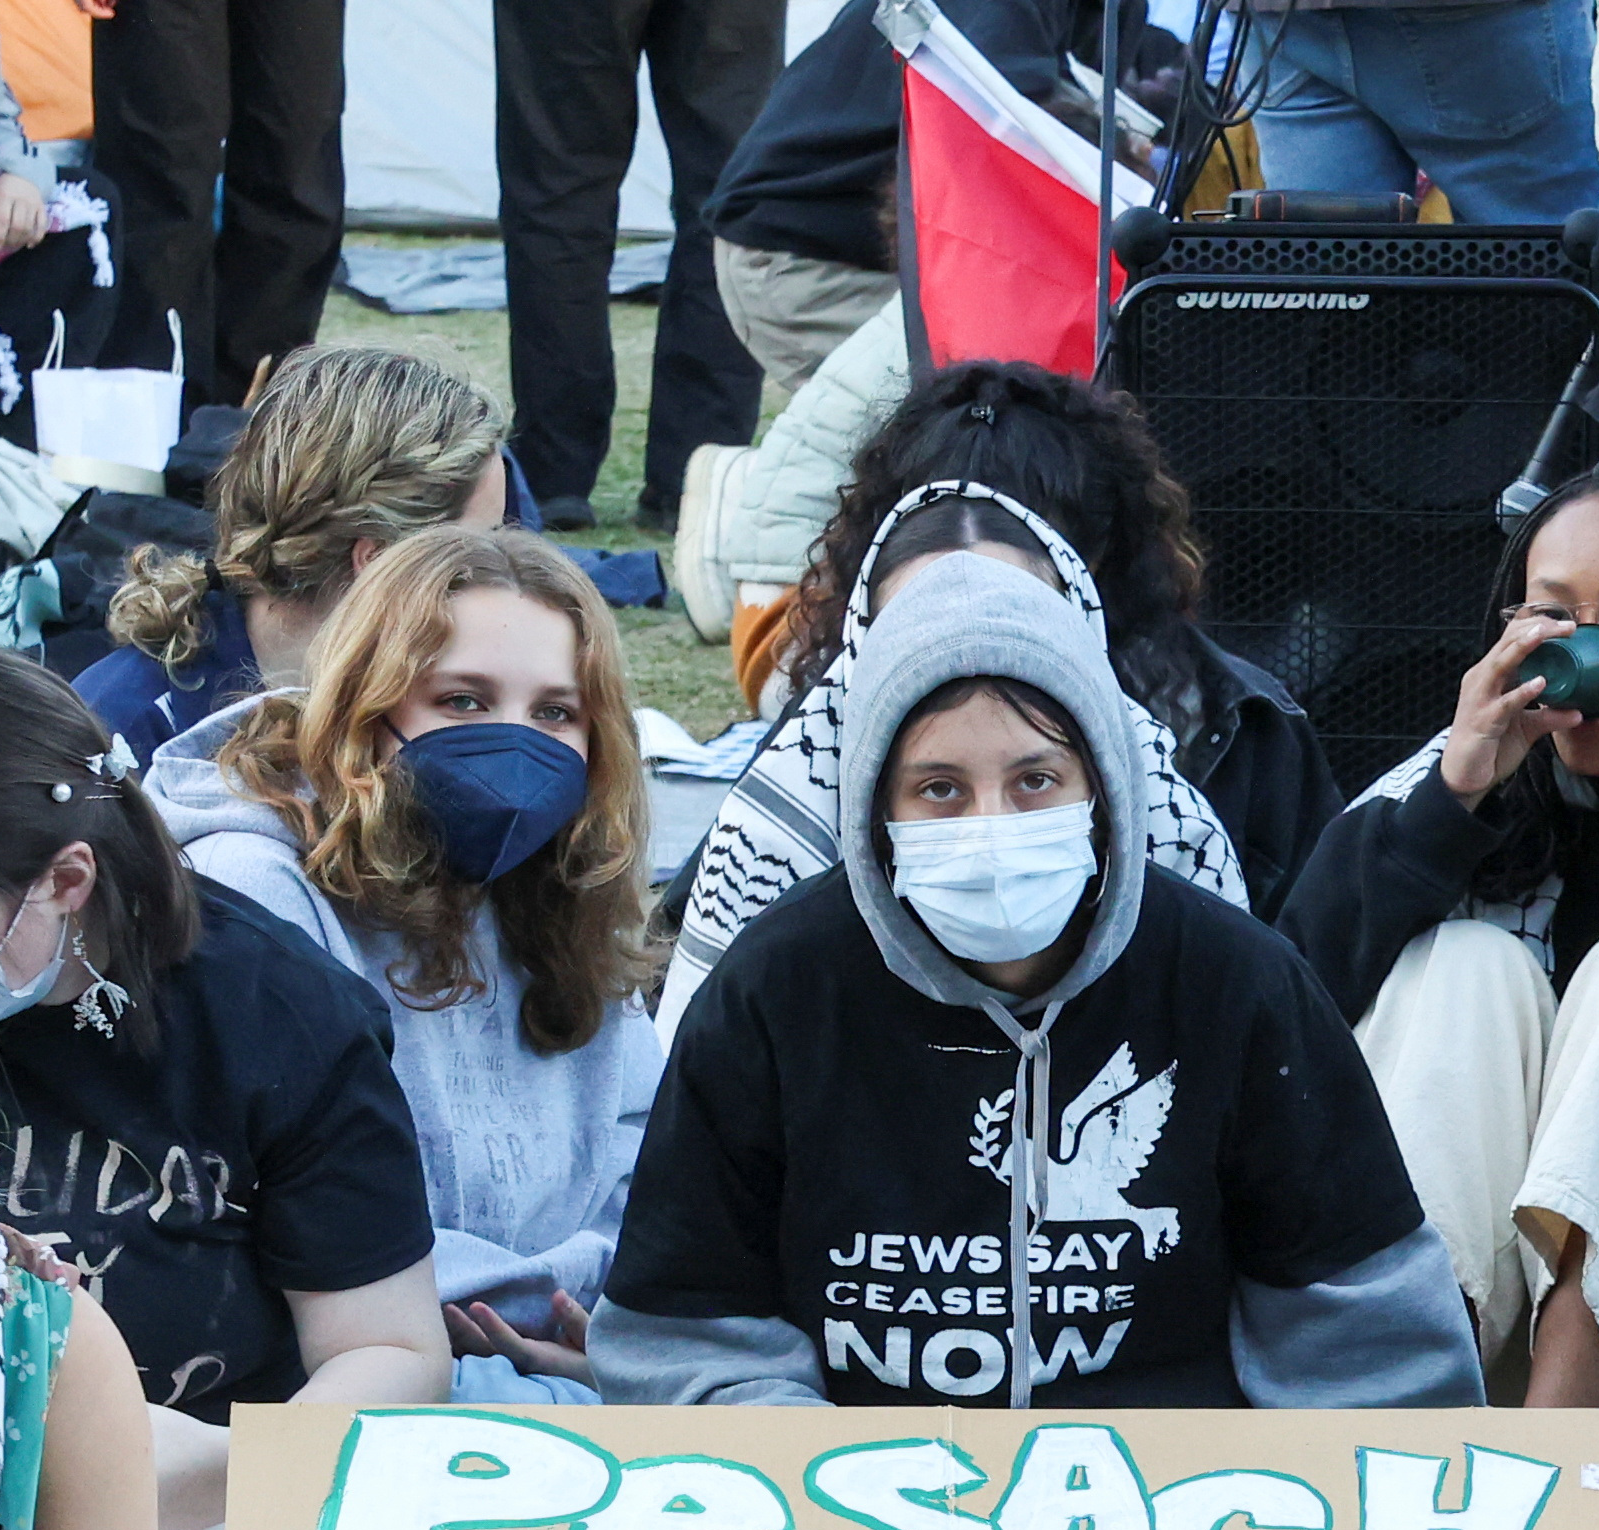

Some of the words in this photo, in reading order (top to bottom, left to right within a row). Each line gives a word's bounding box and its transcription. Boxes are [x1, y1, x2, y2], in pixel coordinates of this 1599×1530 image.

[828, 1231, 1002, 1274] JEWS
[1027, 1232, 1132, 1274] SAY
[824, 1280, 1135, 1316] CEASEFIRE
[823, 1317, 1133, 1397] NOW
